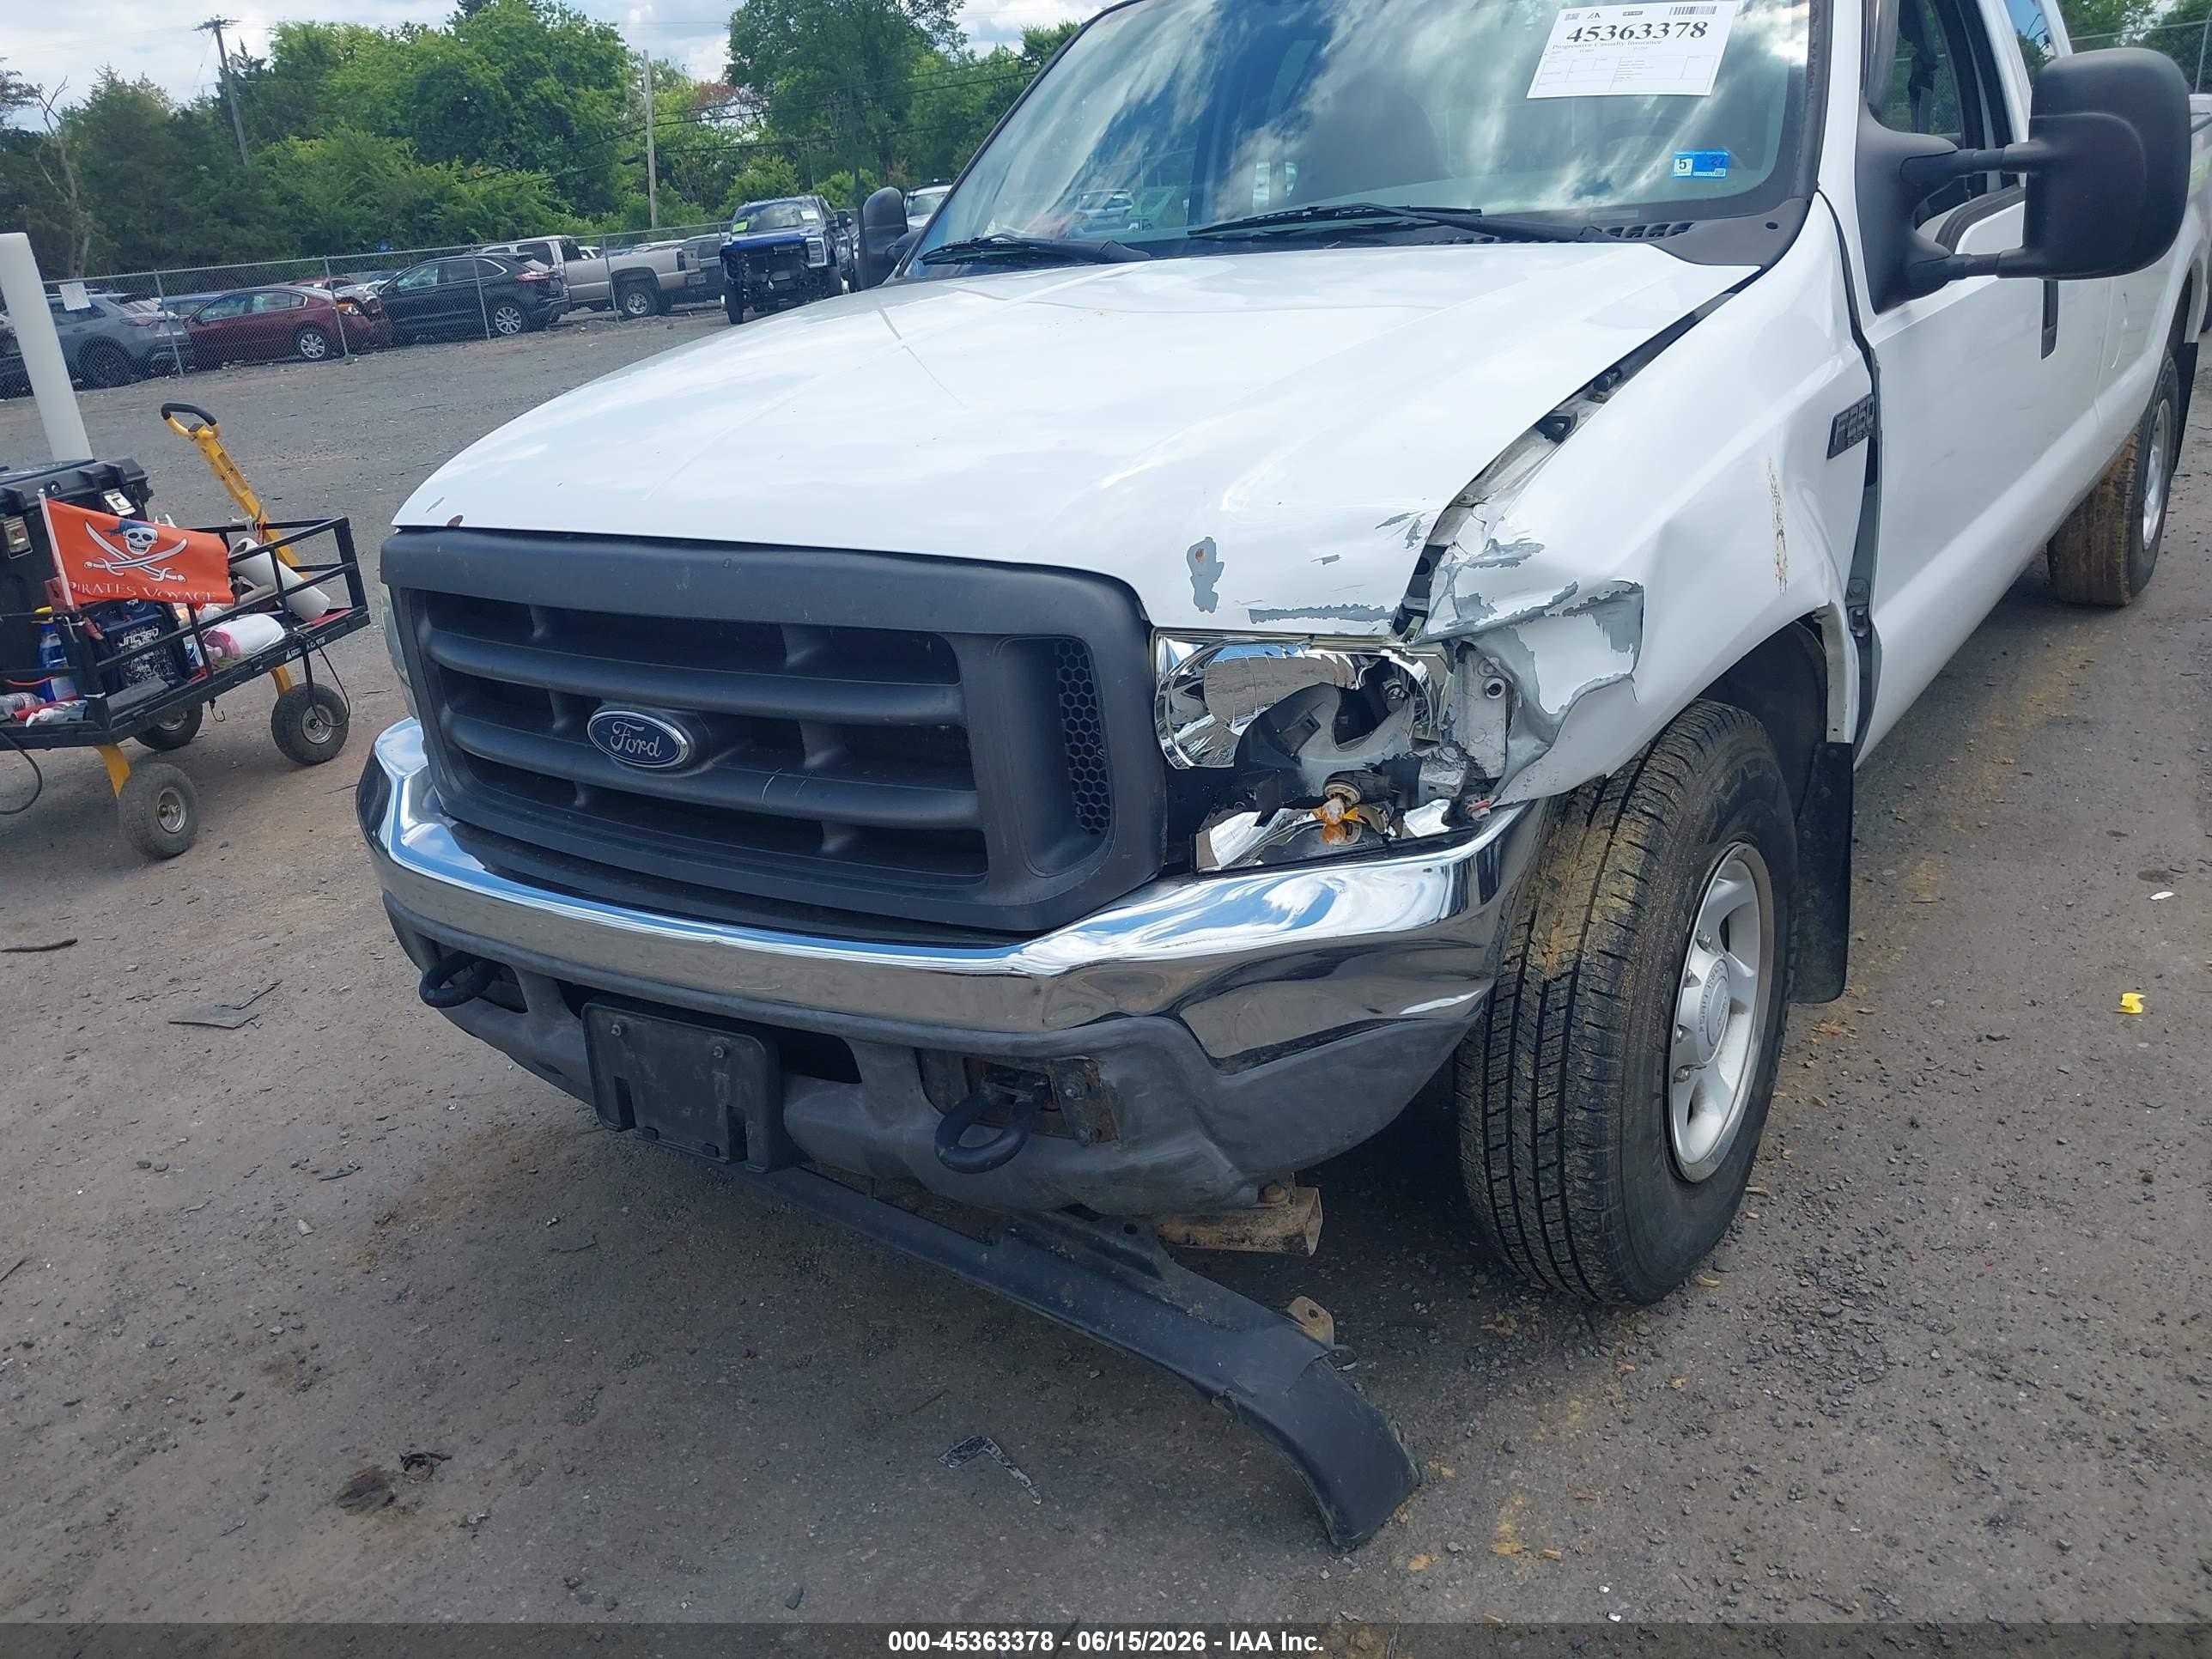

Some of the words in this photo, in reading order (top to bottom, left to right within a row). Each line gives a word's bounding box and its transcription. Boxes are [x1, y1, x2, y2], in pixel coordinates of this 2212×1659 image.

[1566, 21, 1708, 43] 45363378
[1679, 158, 1687, 170] 5
[69, 581, 137, 597] PIRATES
[142, 586, 216, 601] VOYAGE
[610, 721, 661, 757] Ford
